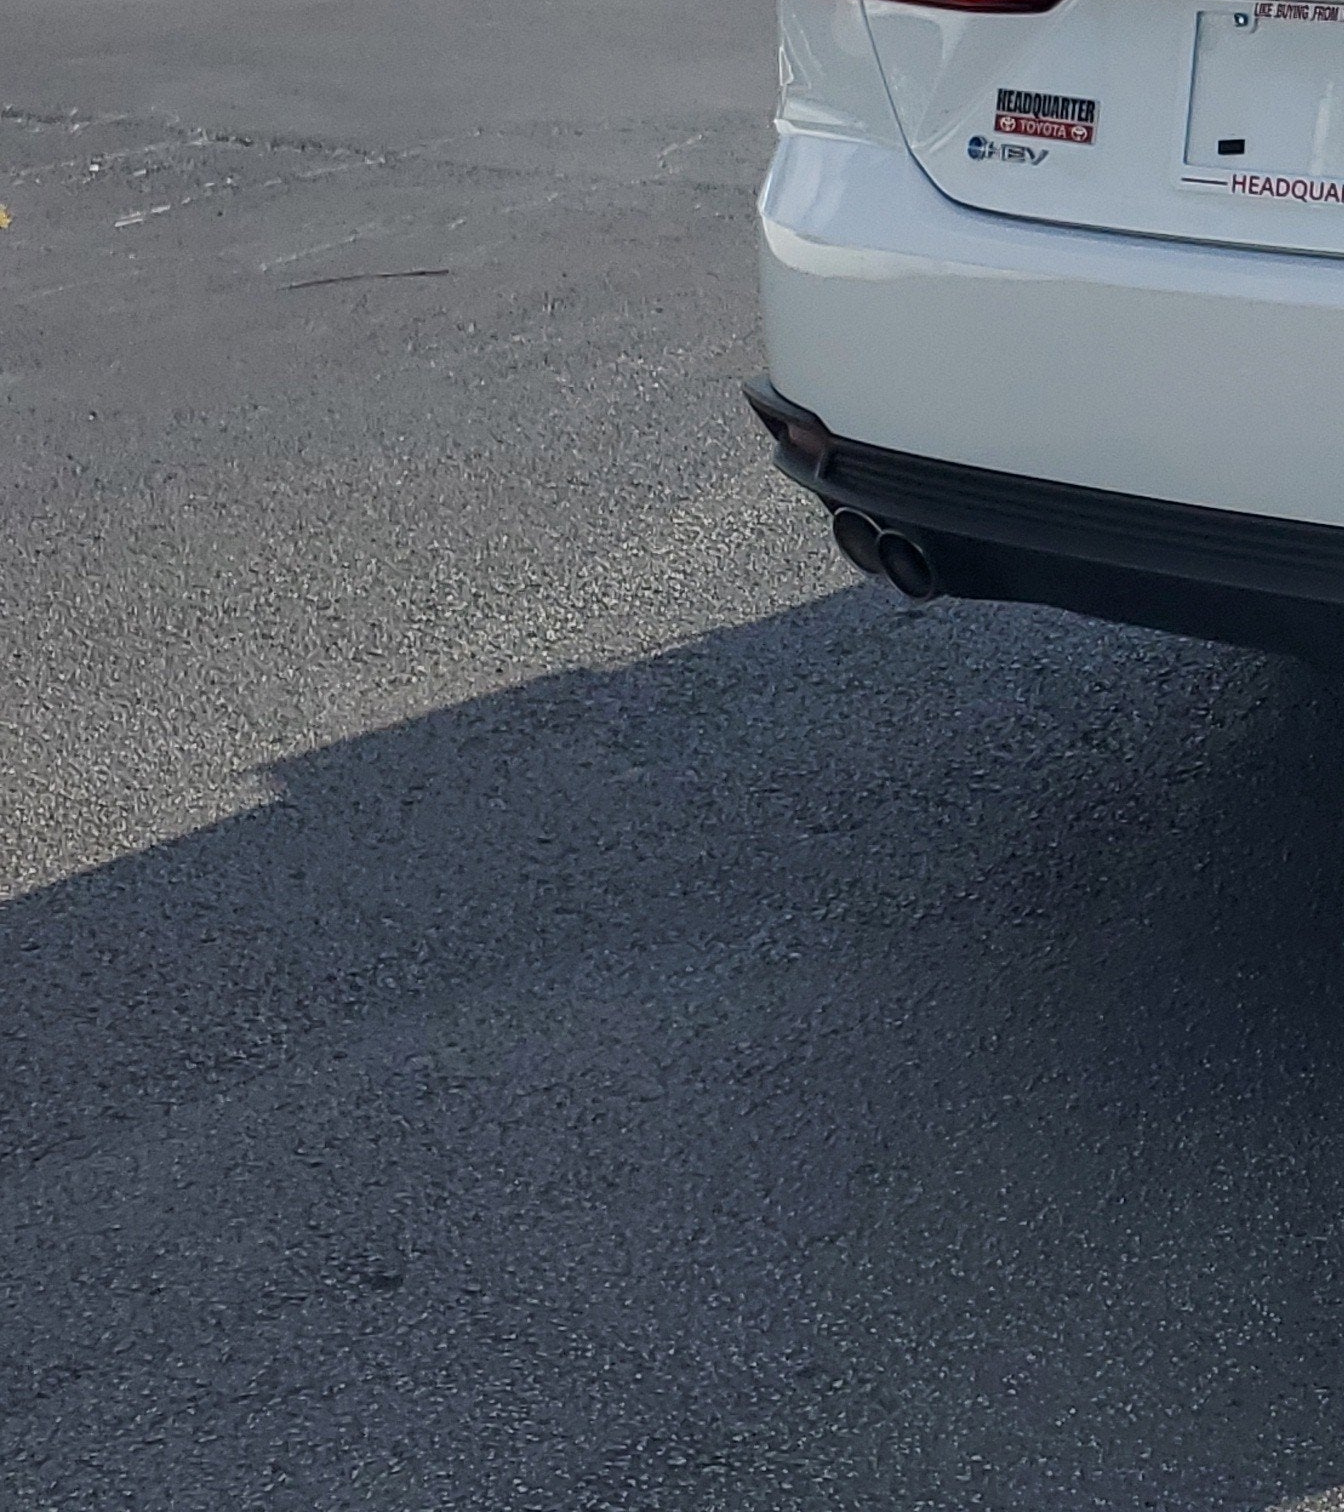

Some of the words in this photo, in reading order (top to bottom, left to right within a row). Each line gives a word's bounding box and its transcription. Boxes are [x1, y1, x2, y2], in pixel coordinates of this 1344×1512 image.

[1254, 2, 1274, 17] LIKE
[1276, 3, 1309, 20] BUYING
[1311, 5, 1339, 22] FROM
[996, 88, 1096, 123] HEADQUARTER
[1019, 119, 1068, 139] TOYOTA
